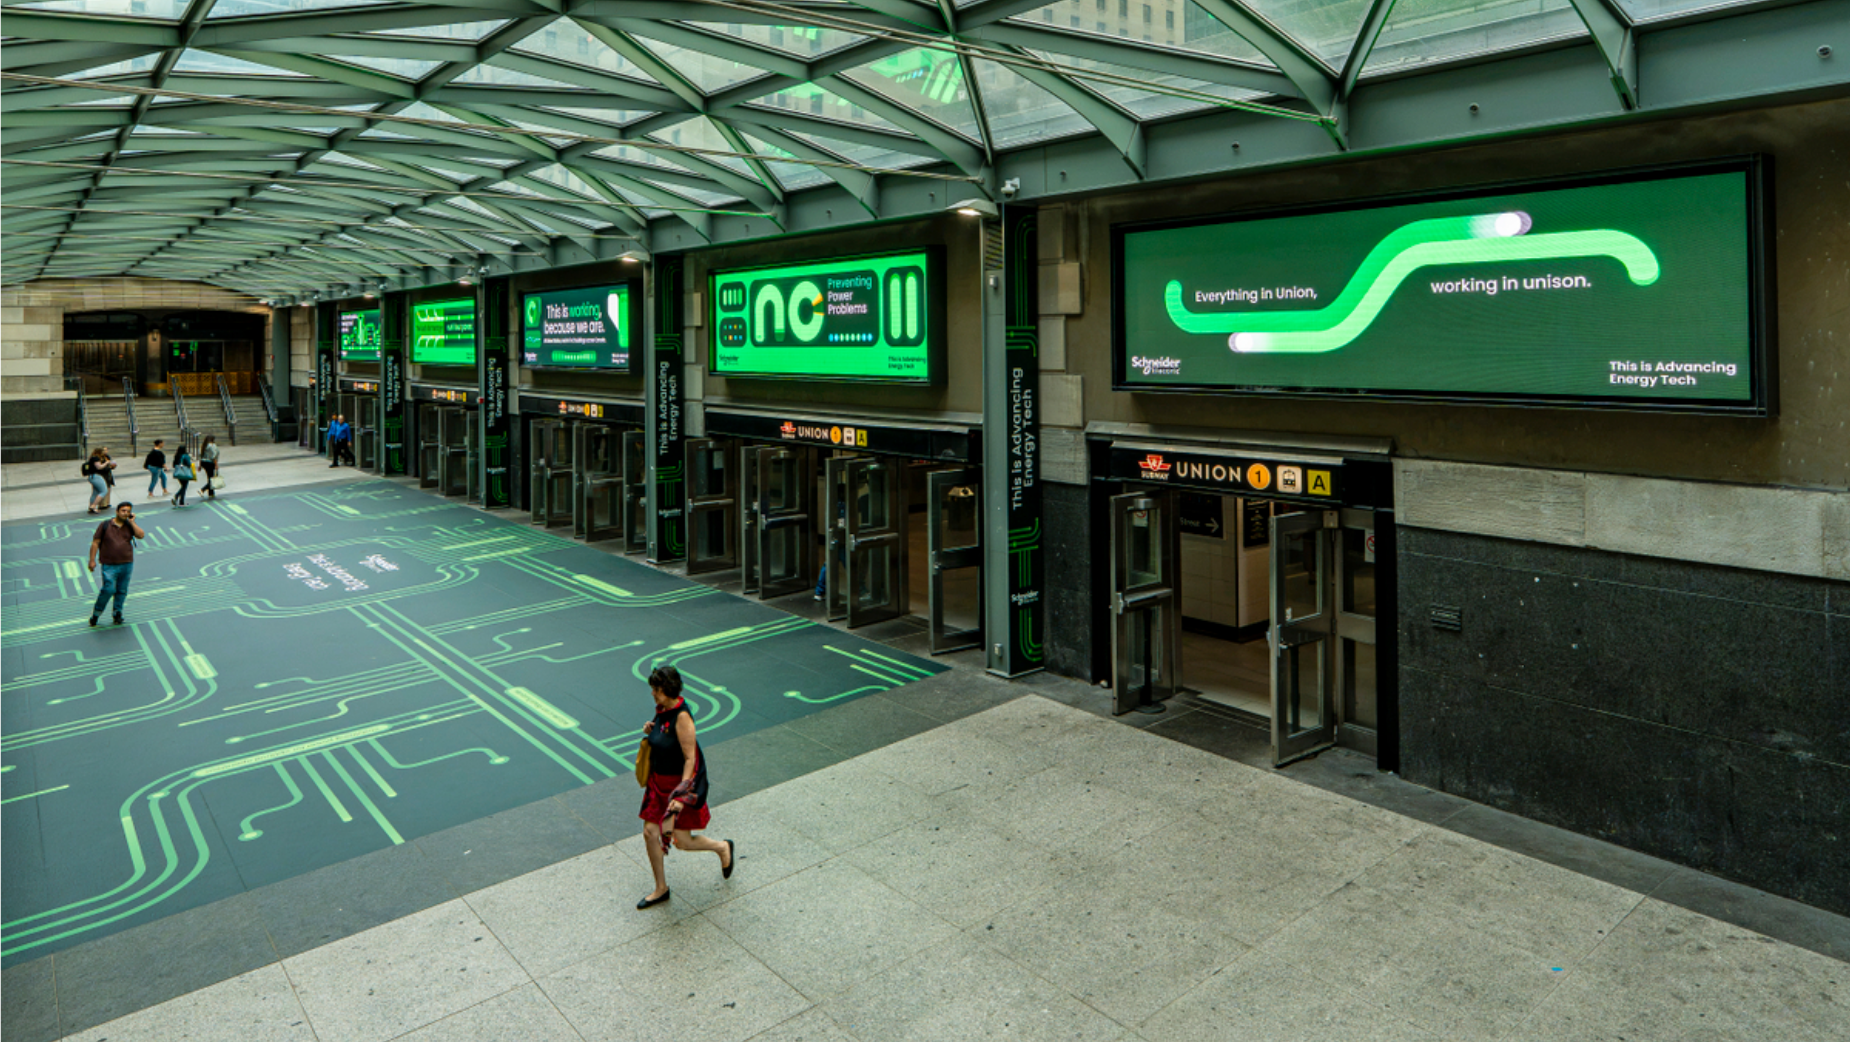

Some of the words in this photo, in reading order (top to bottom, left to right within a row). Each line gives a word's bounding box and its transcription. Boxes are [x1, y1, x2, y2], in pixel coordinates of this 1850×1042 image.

[827, 275, 873, 290] Preventing
[1430, 278, 1498, 295] working
[1502, 276, 1519, 291] in
[1523, 274, 1592, 290] unison.
[827, 291, 853, 302] Power
[1195, 289, 1258, 305] Everything
[1261, 287, 1273, 299] in
[1276, 286, 1318, 299] Union,
[546, 304, 561, 319] This
[562, 303, 569, 319] is
[827, 303, 868, 315] Problems
[544, 320, 576, 334] because
[577, 321, 588, 333] we
[1131, 356, 1181, 374] Schneider
[1609, 361, 1638, 372] This
[1640, 361, 1653, 372] is
[1655, 361, 1737, 376] Advancing
[487, 357, 497, 400] Advancing
[668, 374, 678, 402] Tech
[1609, 373, 1658, 387] Energy
[1660, 374, 1697, 386] Tech
[658, 361, 671, 420] Advancing
[1009, 367, 1024, 456] Advancing
[1022, 388, 1033, 429] Tech
[658, 421, 668, 432] is
[668, 403, 680, 441] Energy
[798, 426, 829, 439] UNION
[659, 433, 669, 456] This
[1011, 459, 1023, 474] is
[1023, 432, 1036, 488] Energy
[1141, 470, 1170, 480] SUBWAY
[1176, 461, 1241, 483] UNION
[1011, 476, 1023, 511] This
